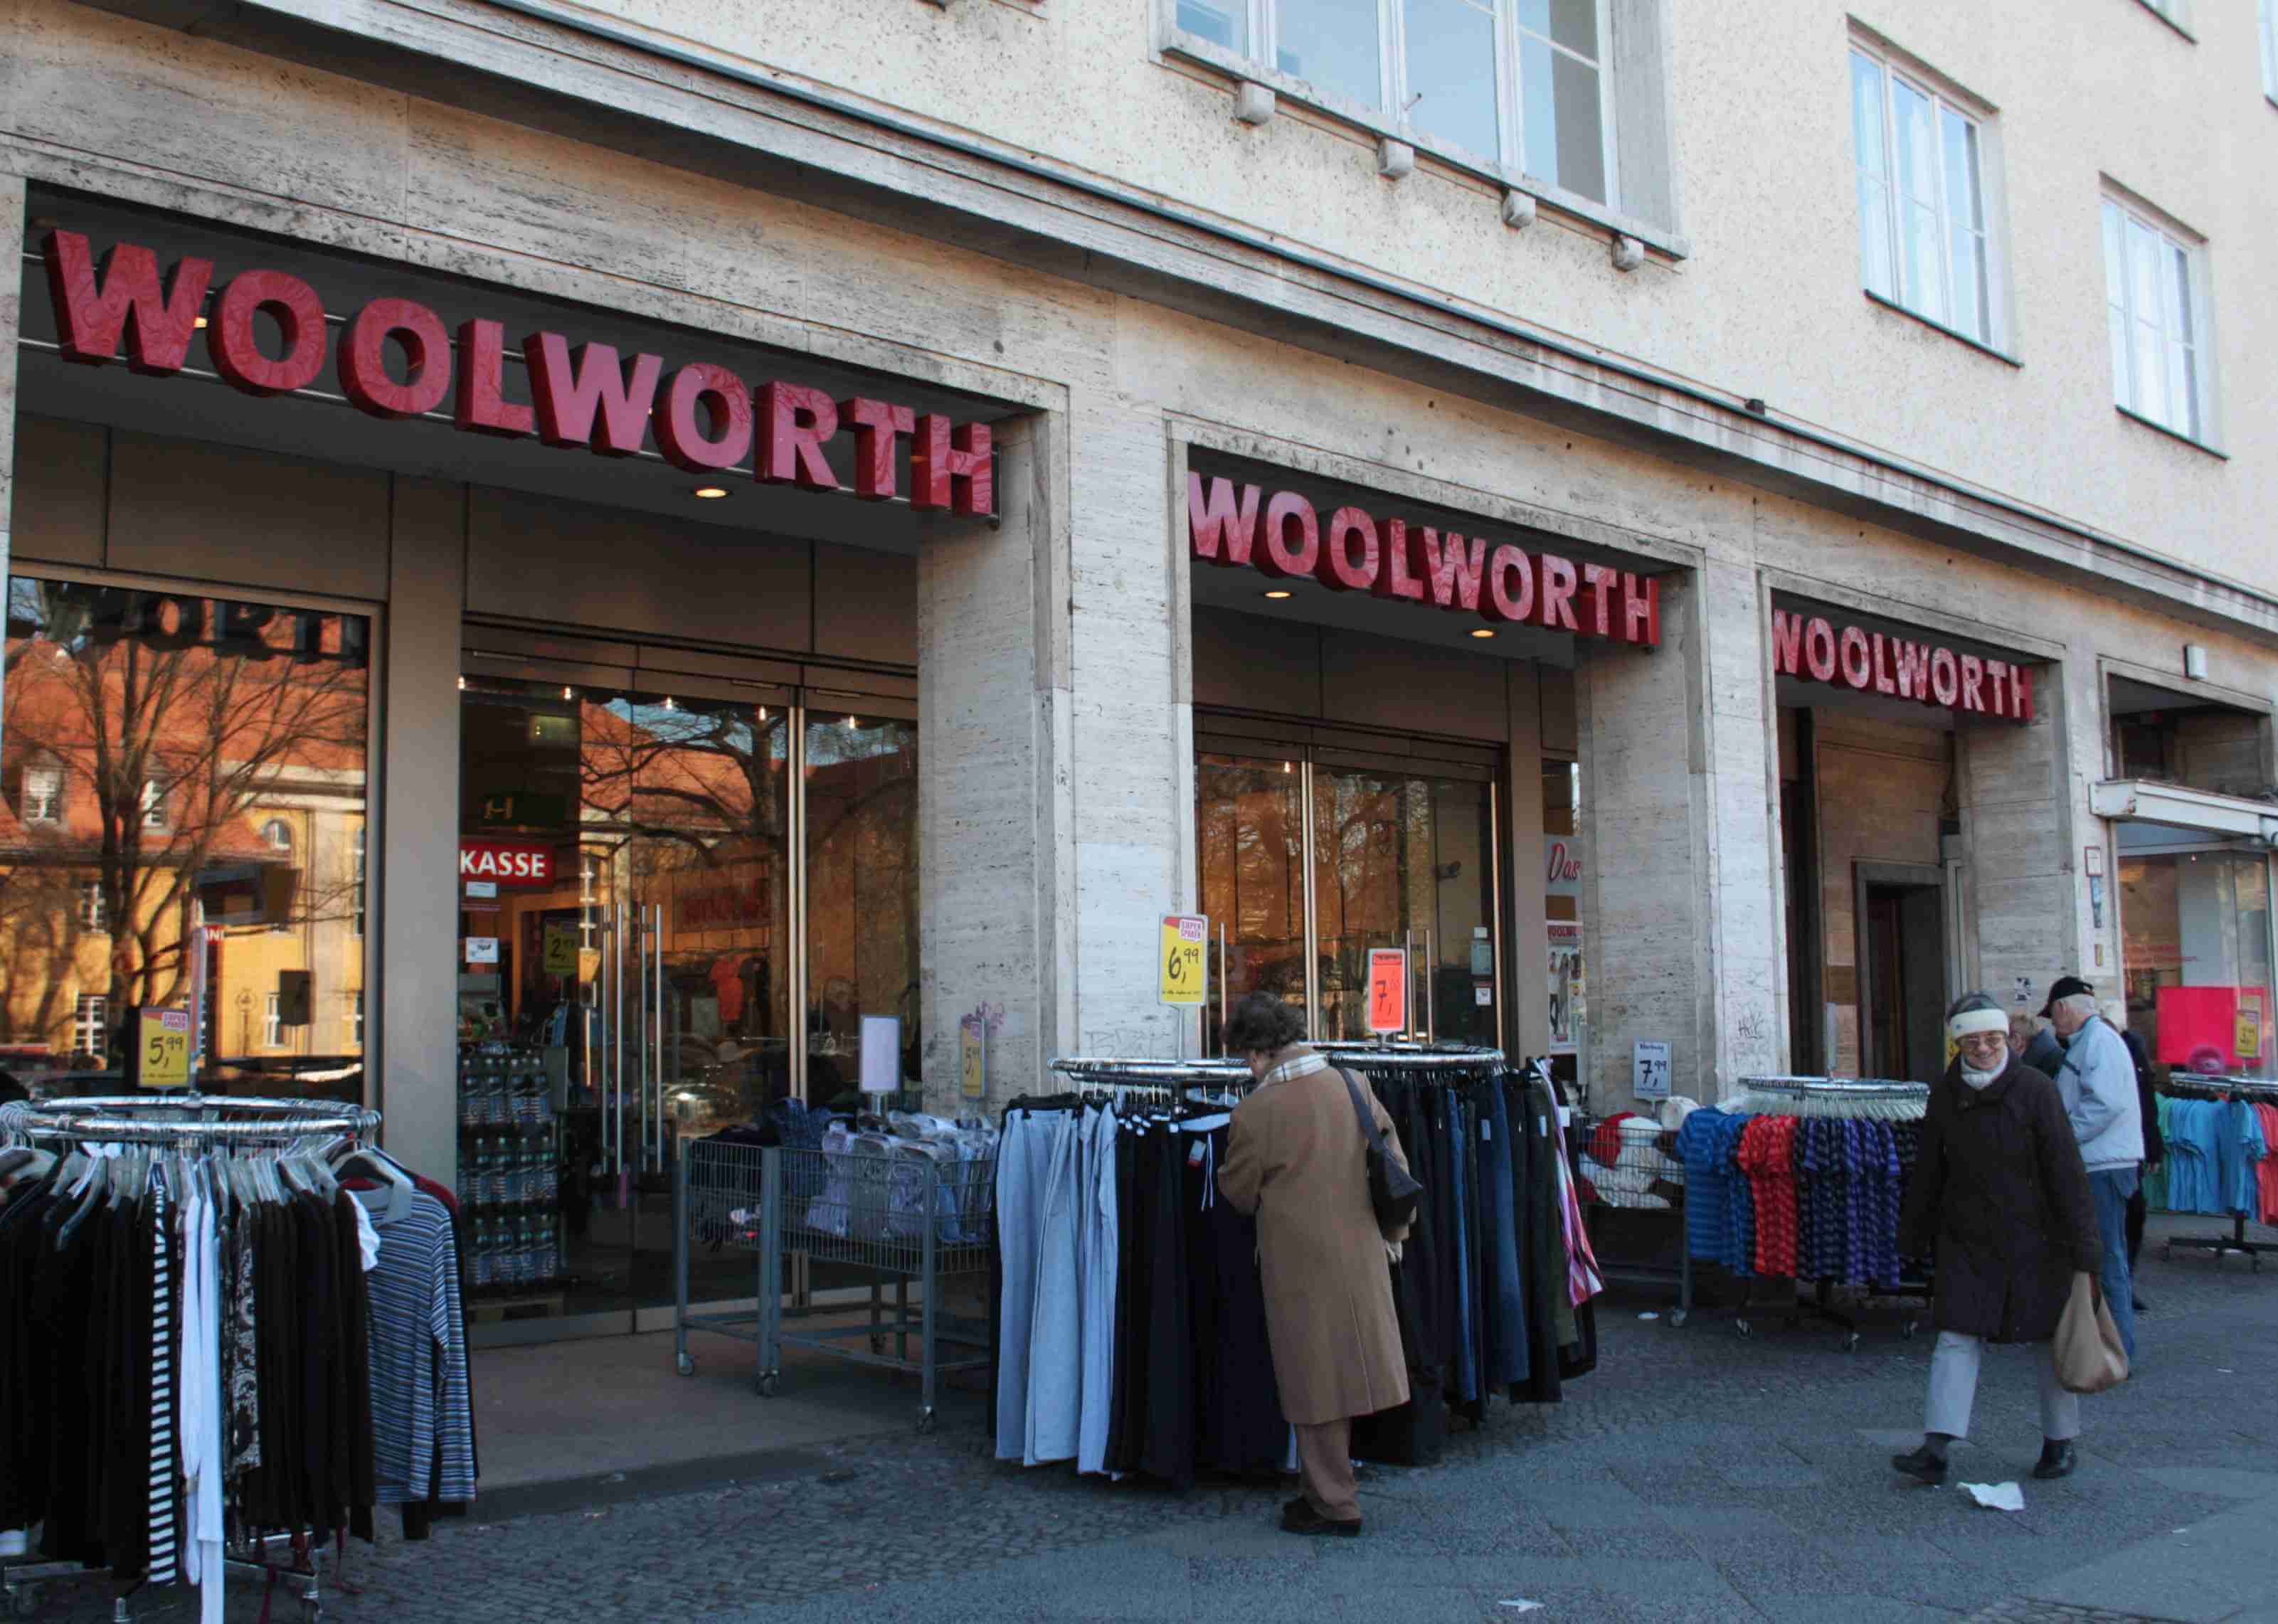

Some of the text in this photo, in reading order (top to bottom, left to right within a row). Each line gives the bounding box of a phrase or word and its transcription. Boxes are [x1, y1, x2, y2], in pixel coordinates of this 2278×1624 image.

[46, 229, 993, 516] WOOLWORTH
[1188, 469, 1659, 645] WOOLWORTH
[1772, 608, 2035, 721] WOOLWORTH
[460, 849, 546, 877] KASSE
[1169, 947, 1199, 985] 6,99
[149, 1036, 184, 1068] 5,99
[1639, 1059, 1667, 1088] 7,99
